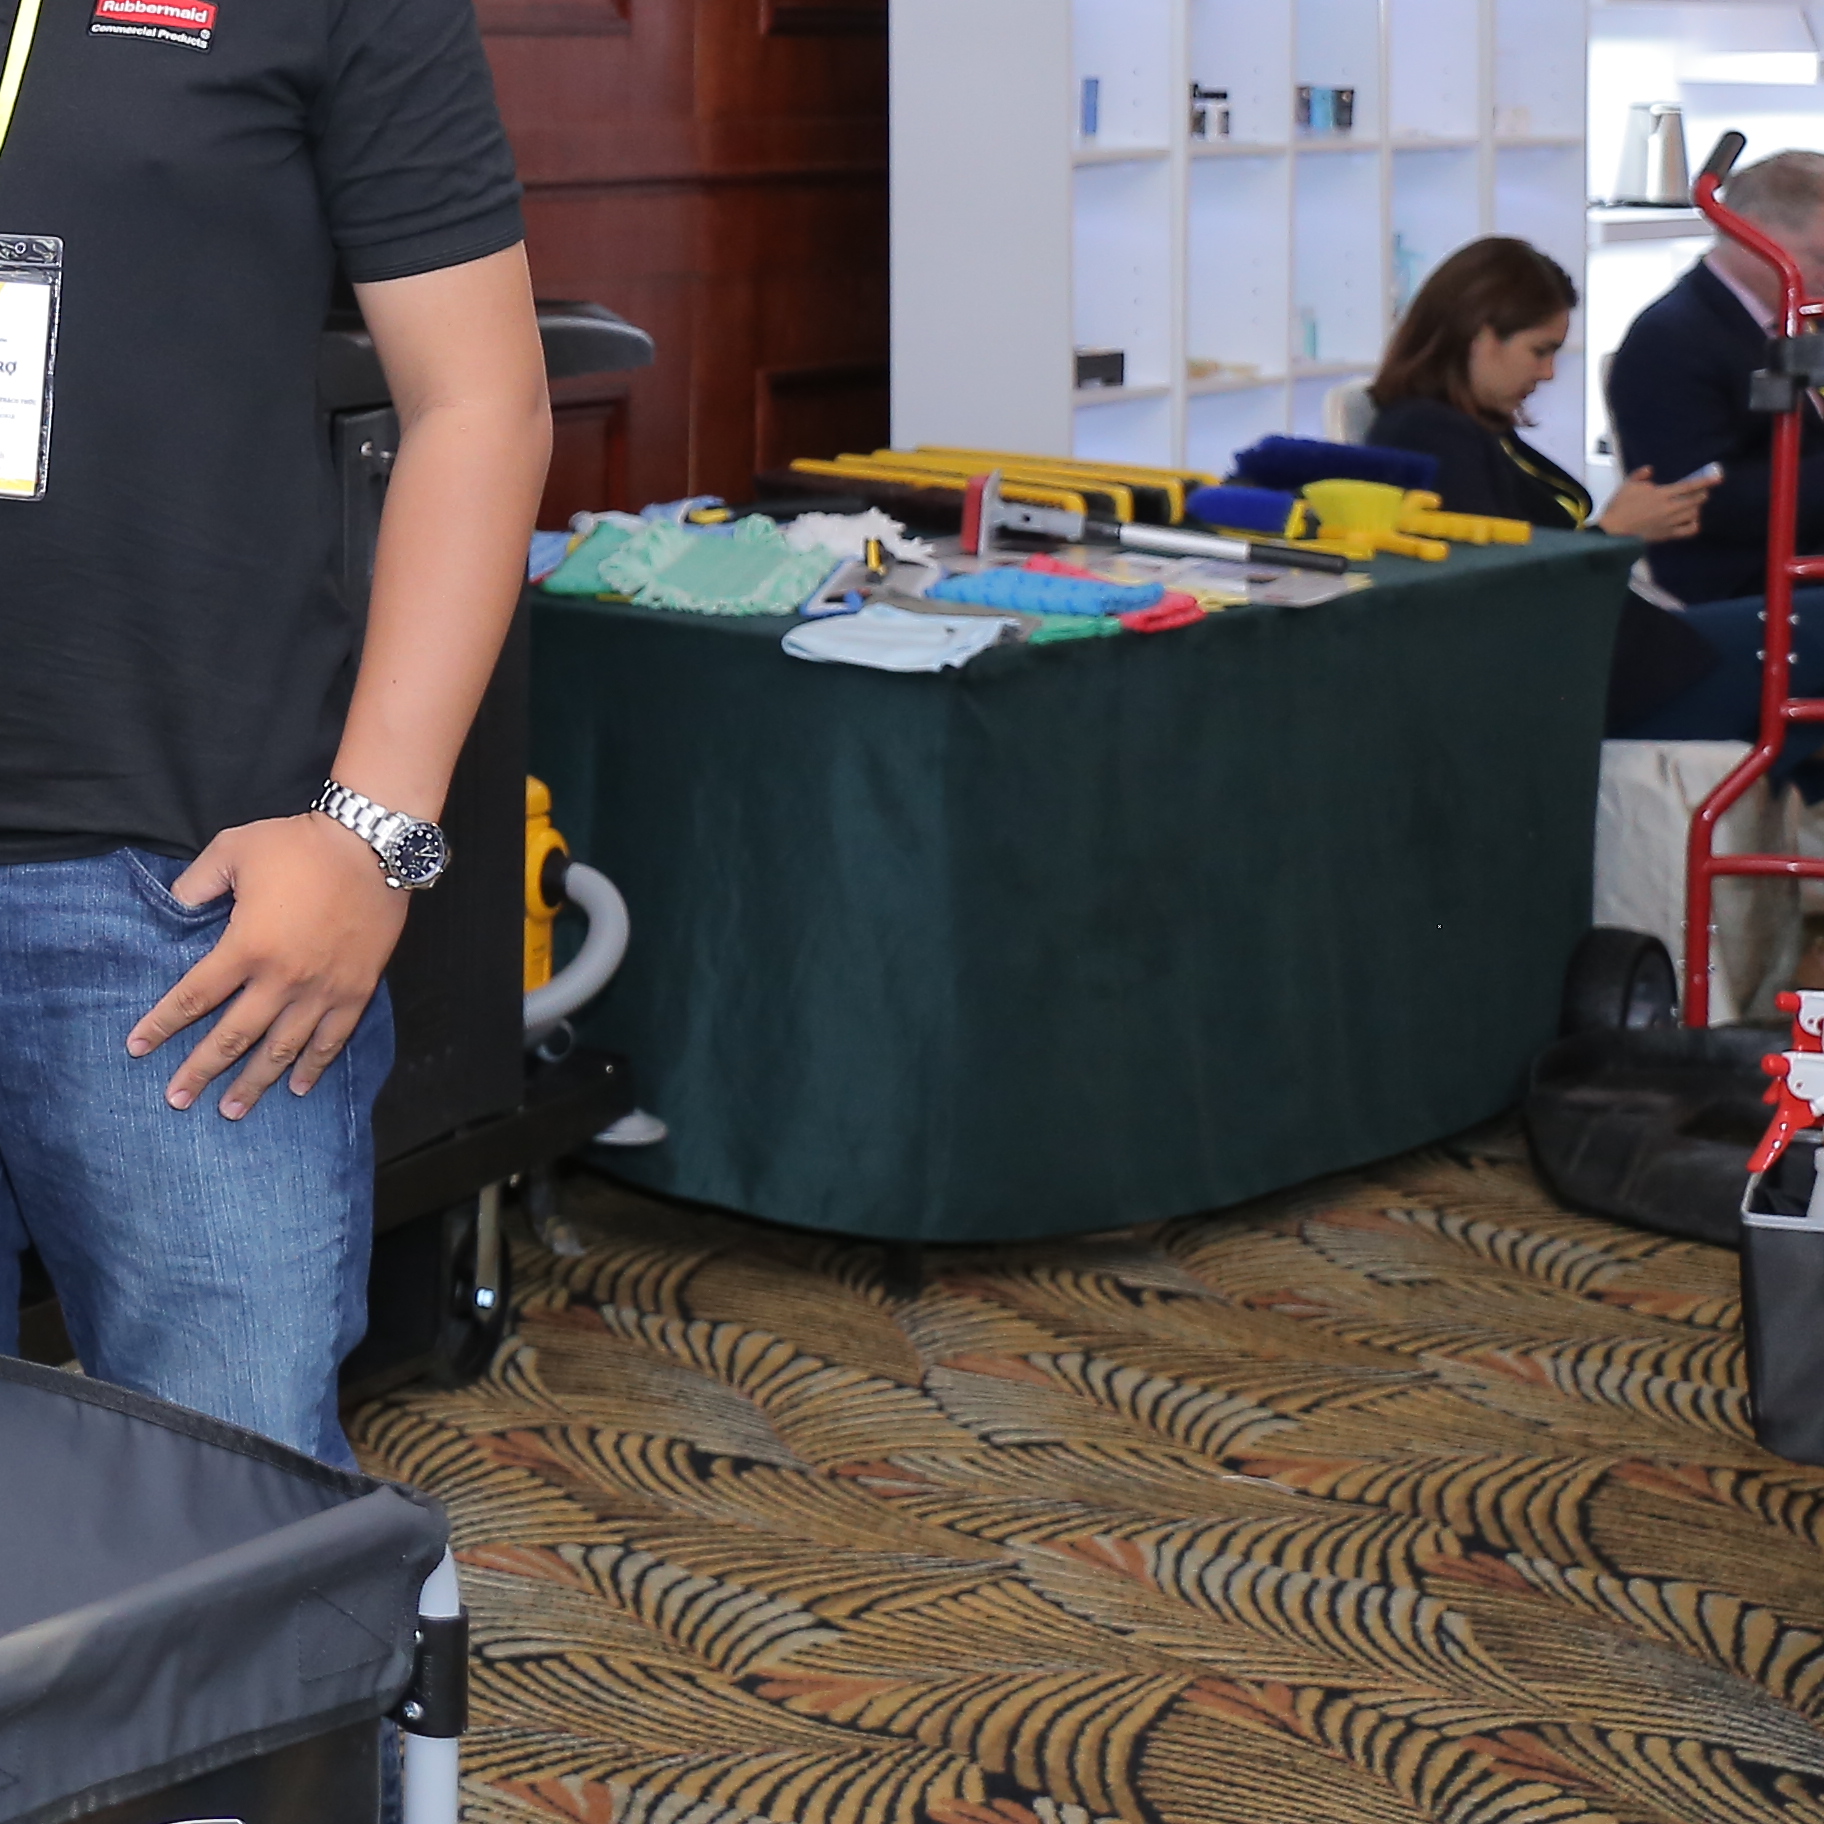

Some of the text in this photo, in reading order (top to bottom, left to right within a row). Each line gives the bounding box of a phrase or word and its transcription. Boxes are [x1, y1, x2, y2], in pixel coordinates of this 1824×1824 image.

[103, 0, 208, 23] Rubbermaid
[91, 23, 209, 49] Commercial Products
